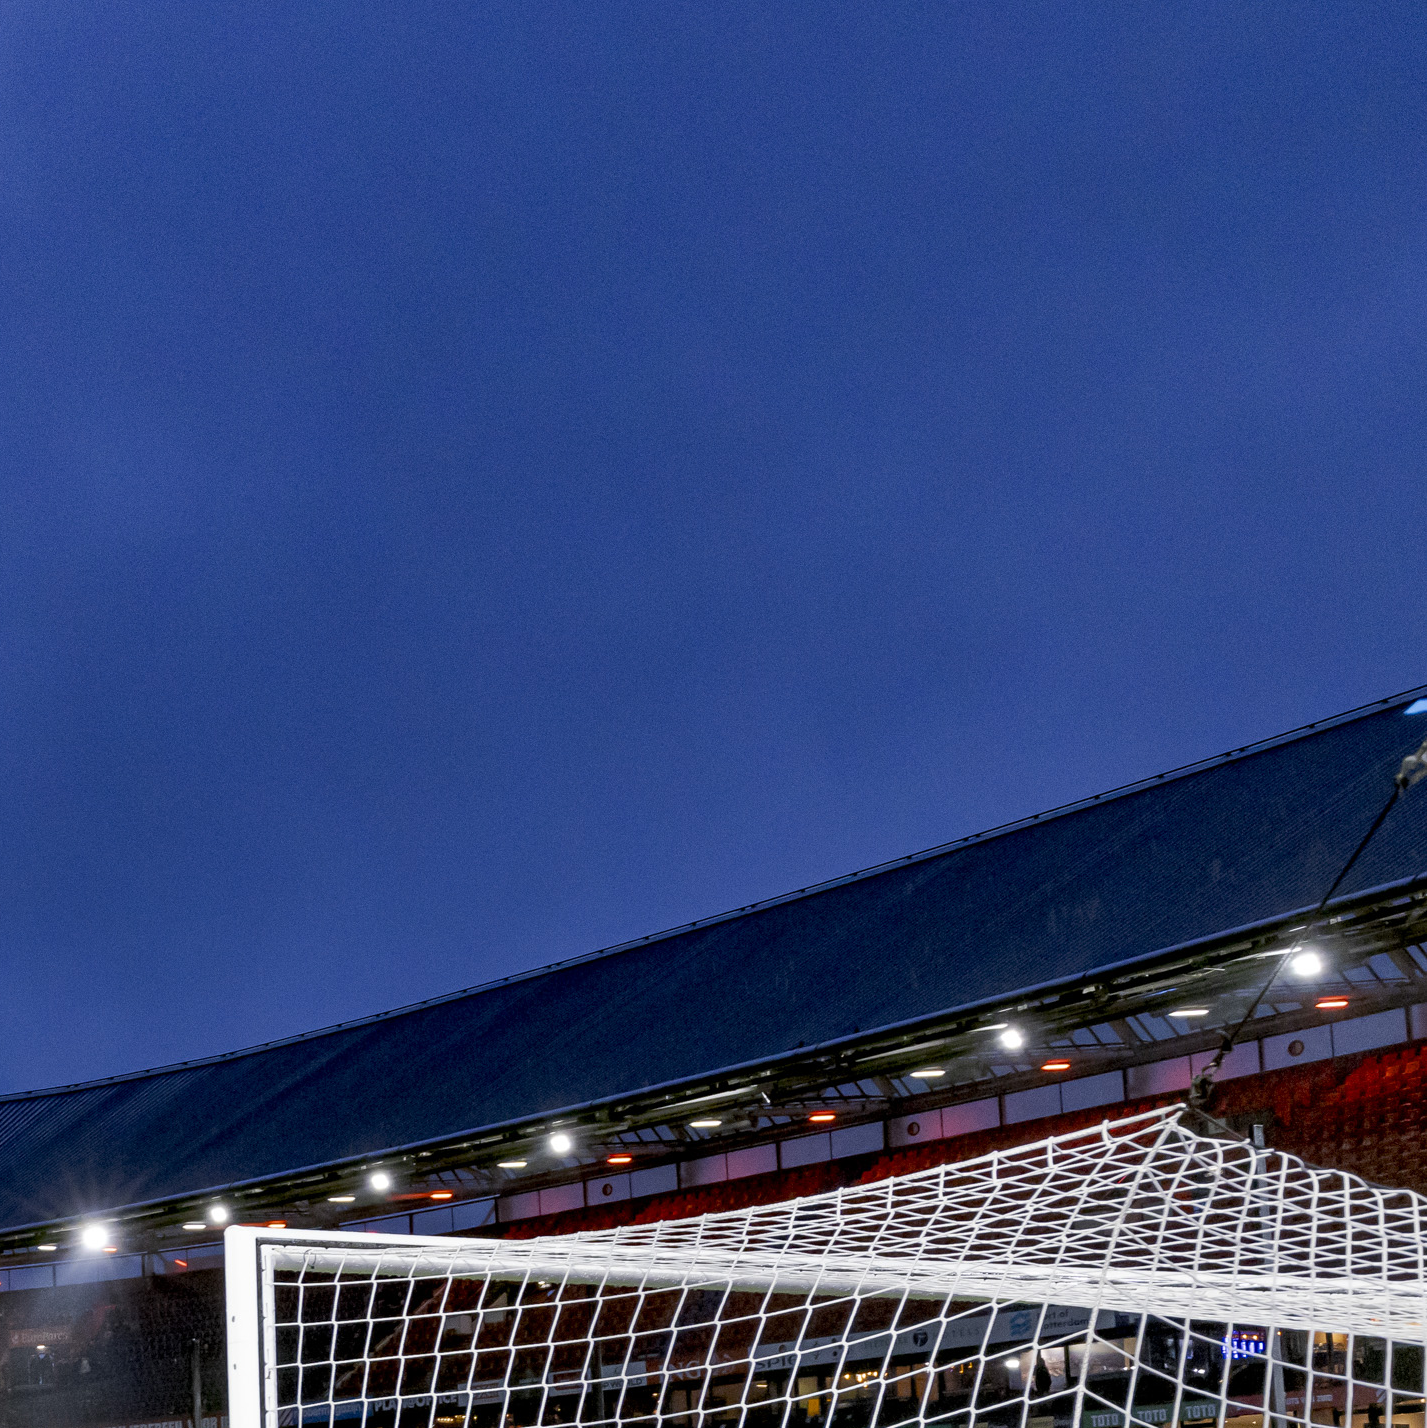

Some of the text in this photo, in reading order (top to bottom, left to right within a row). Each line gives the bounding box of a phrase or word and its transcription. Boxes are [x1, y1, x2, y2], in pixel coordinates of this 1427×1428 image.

[1040, 1318, 1089, 1330] otterdam
[1185, 1404, 1216, 1418] TOTO
[1091, 1413, 1119, 1427] TOTO
